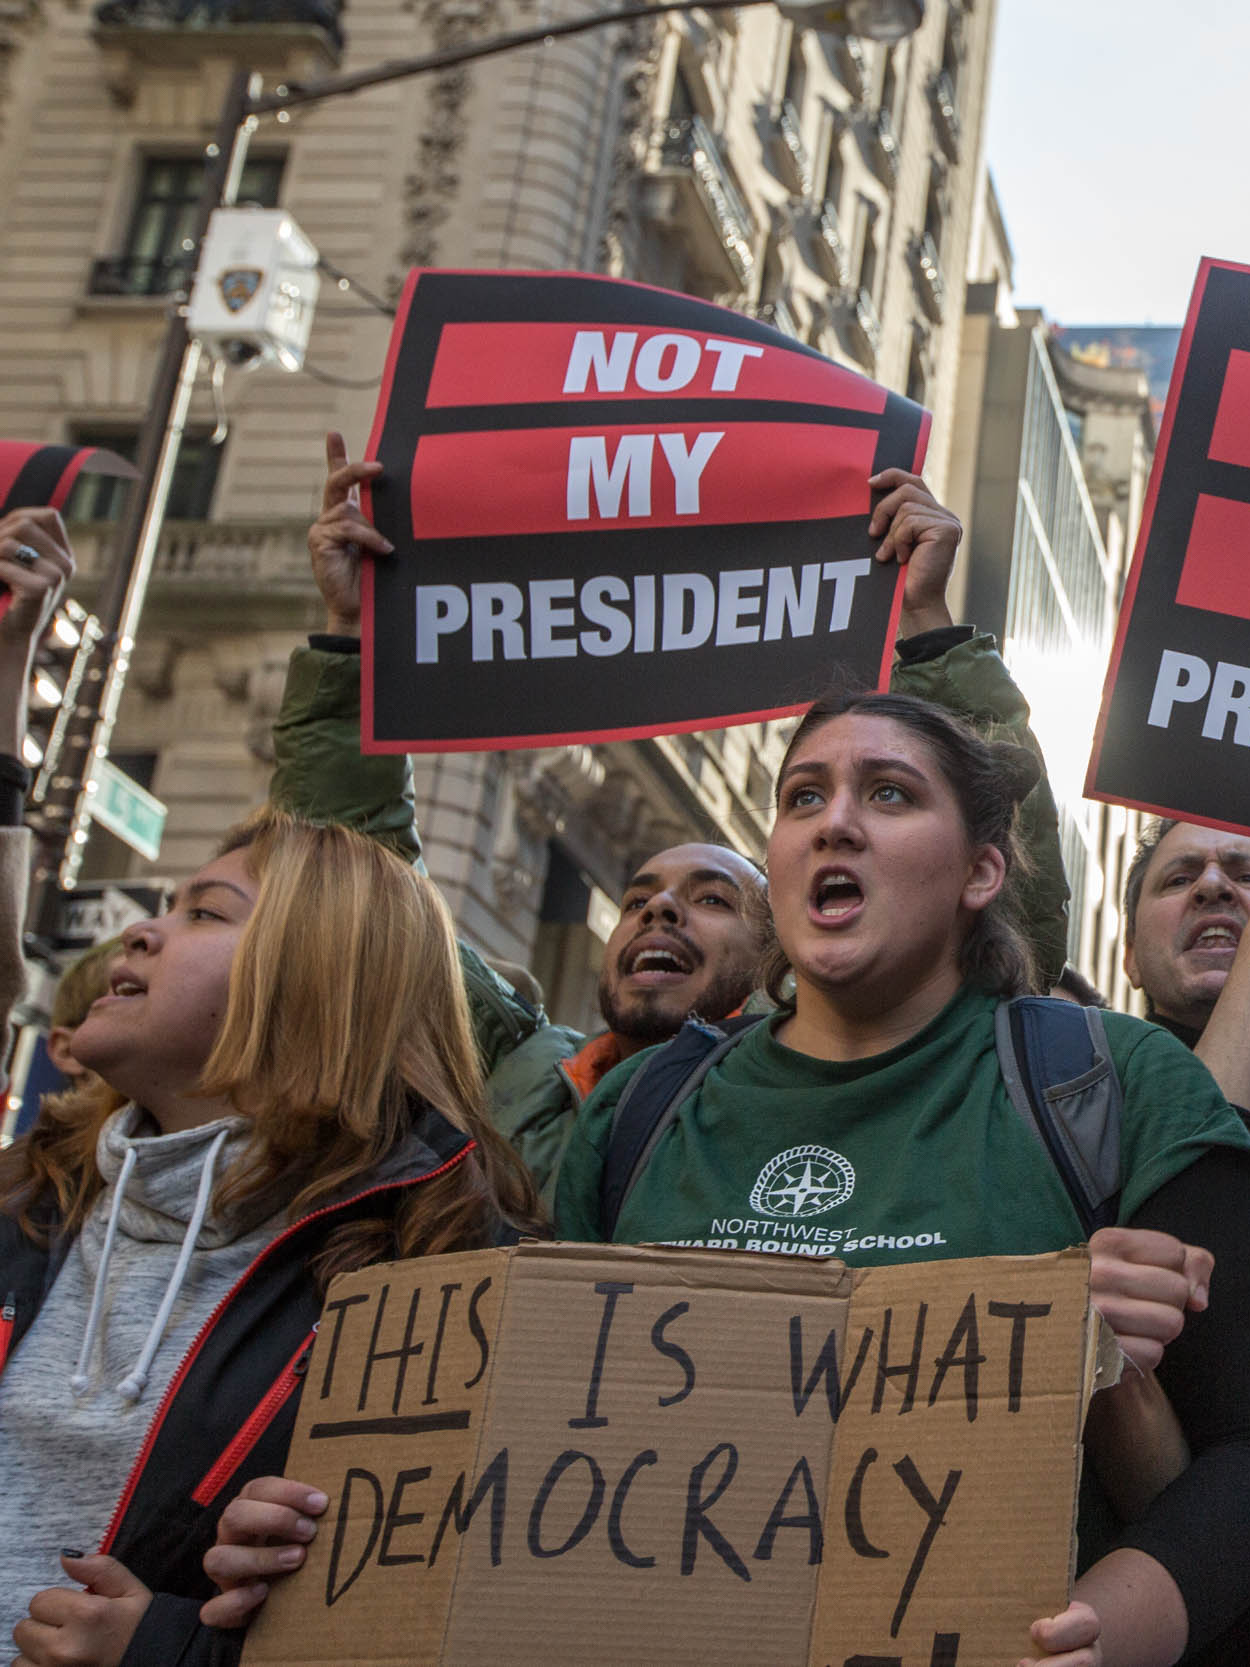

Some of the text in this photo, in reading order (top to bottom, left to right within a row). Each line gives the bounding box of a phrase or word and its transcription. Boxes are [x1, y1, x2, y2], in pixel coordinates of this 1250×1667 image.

[562, 331, 764, 394] NOT
[566, 432, 726, 520] MY
[415, 558, 872, 664] PRESIDENT
[711, 1218, 857, 1242] NORTHWEST
[745, 1239, 836, 1256] BOUND
[842, 1232, 947, 1252] SCHOOL
[320, 1276, 1053, 1430] THIS IS WHAT
[326, 1443, 962, 1639] DEMOCRACY
